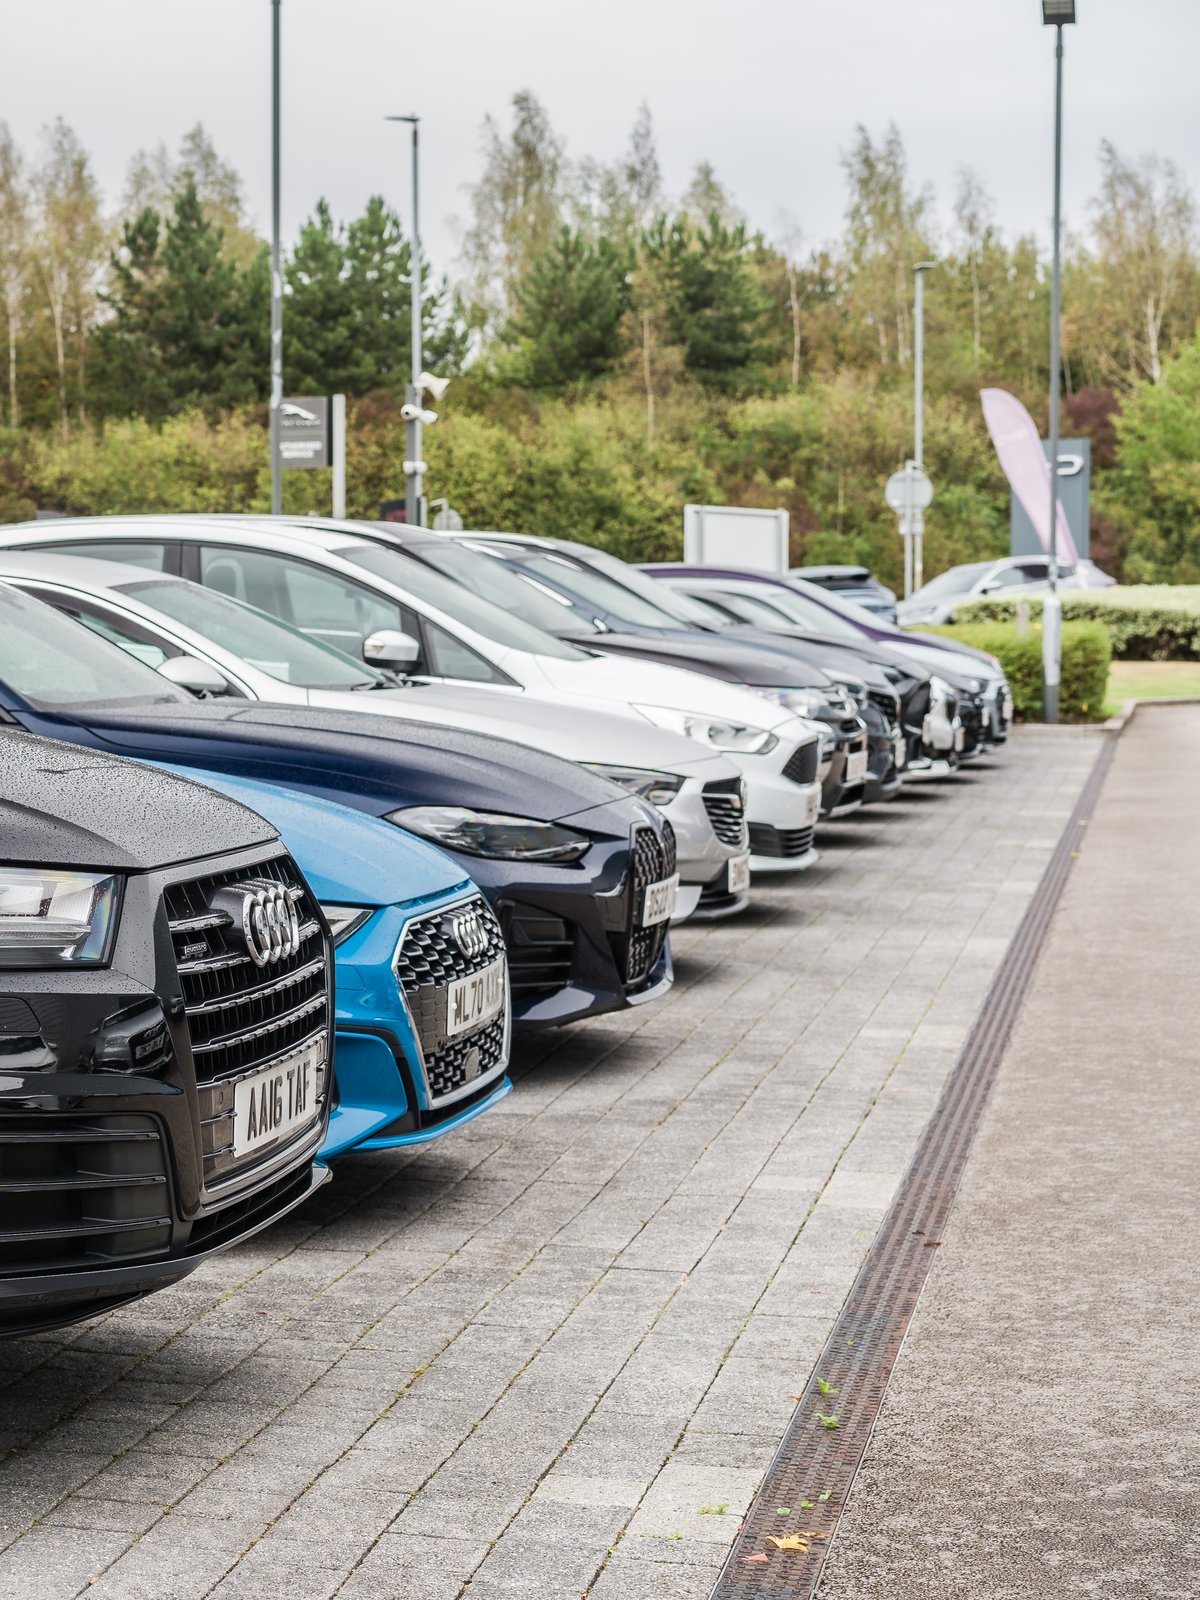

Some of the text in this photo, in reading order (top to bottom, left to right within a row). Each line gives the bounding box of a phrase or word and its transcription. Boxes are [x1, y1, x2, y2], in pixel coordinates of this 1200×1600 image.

[454, 977, 484, 1027] ML70
[247, 1060, 311, 1142] AA16 TAF
